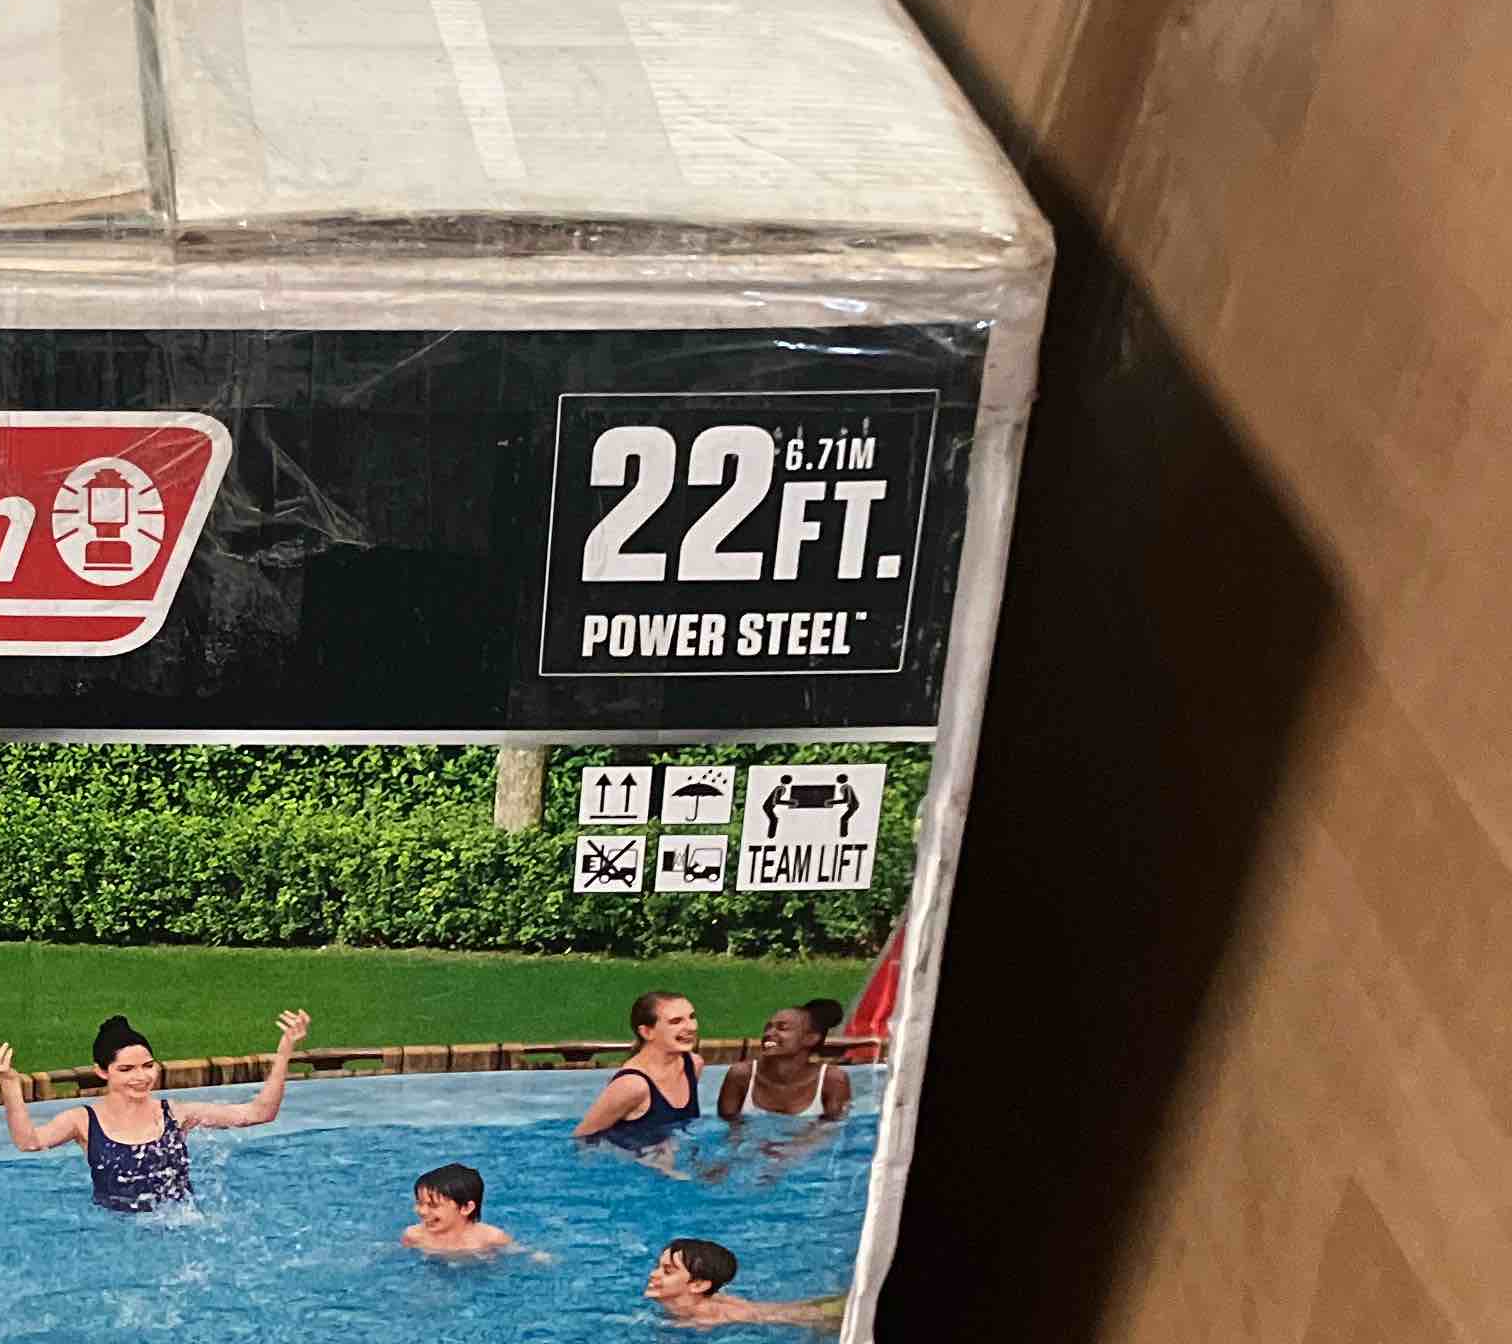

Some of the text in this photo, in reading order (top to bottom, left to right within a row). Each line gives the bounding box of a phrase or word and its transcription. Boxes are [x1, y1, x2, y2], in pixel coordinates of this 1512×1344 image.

[784, 436, 877, 471] 6.71M
[581, 425, 902, 582] 22 FT.
[581, 613, 728, 658] POWER
[747, 842, 869, 884] TEAM LIFT
